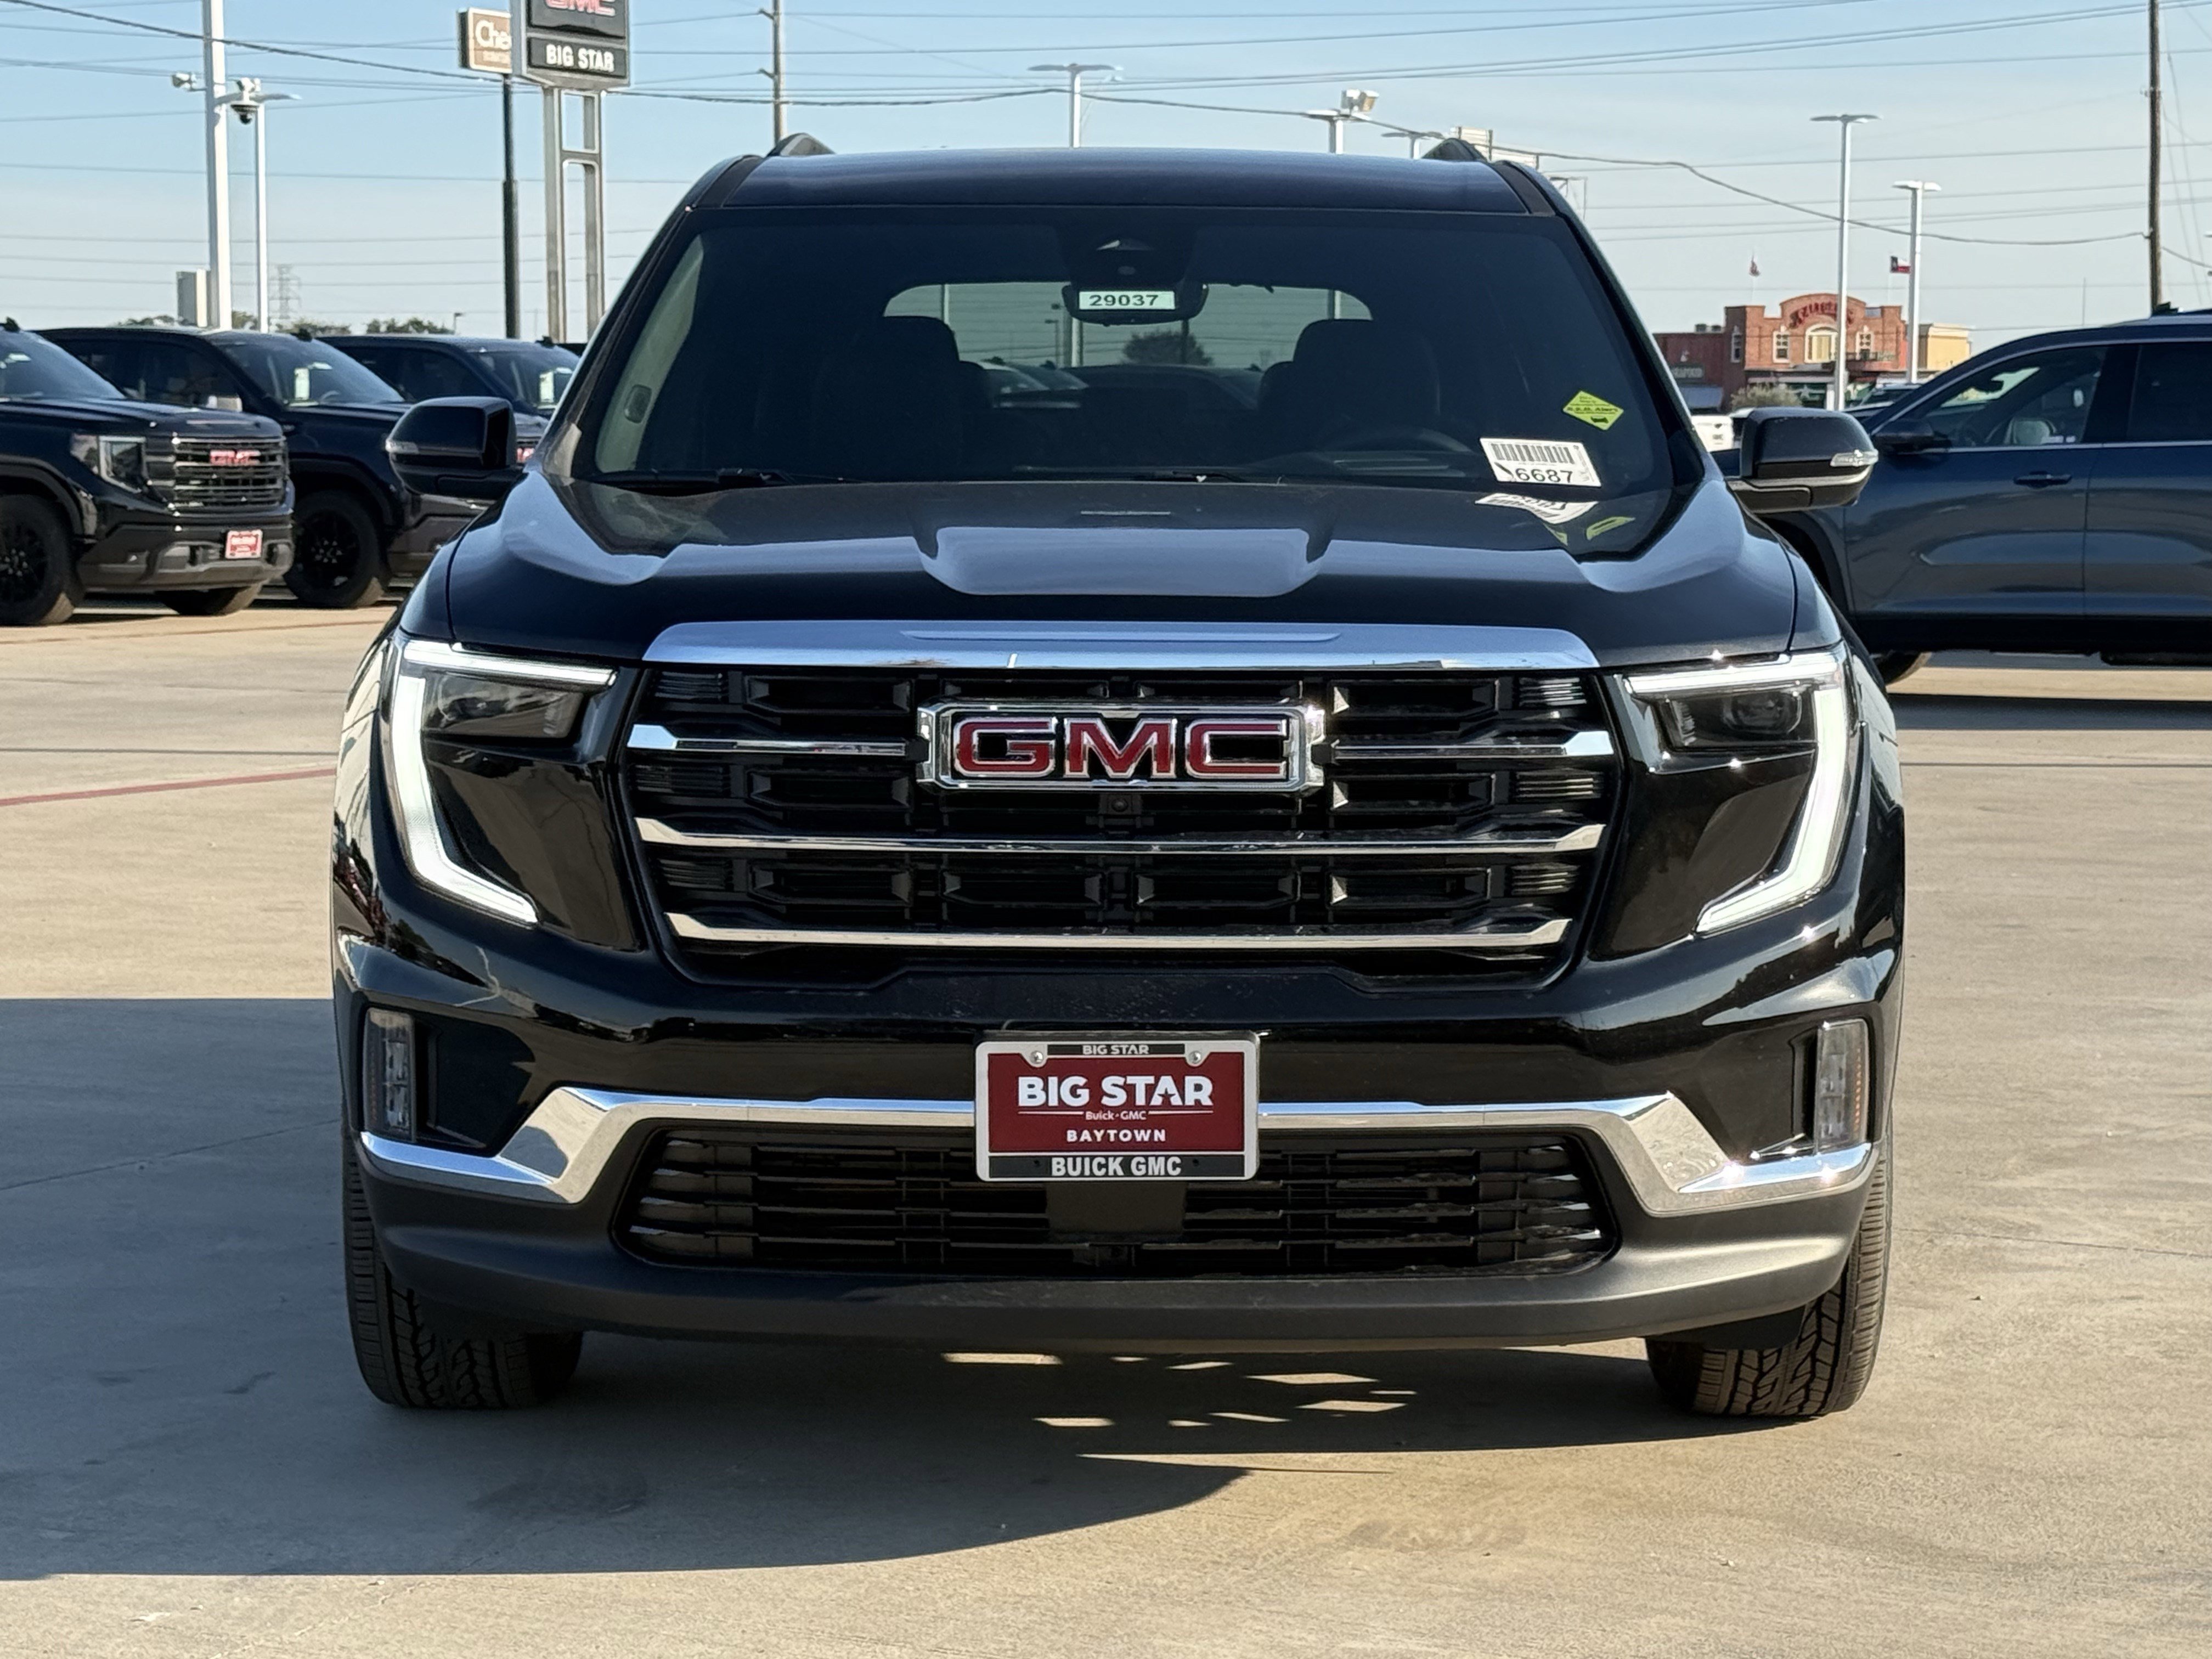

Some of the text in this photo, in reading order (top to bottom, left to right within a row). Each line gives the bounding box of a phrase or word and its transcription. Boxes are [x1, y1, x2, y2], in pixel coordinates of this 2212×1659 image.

[546, 44, 614, 72] BIG STAR
[1089, 294, 1159, 306] 29037
[954, 716, 1287, 780] GMC
[1082, 1045, 1149, 1054] BIG STAR
[1018, 1075, 1214, 1107] BIG STAR
[1066, 1129, 1166, 1142] BAYTOWN
[1051, 1156, 1182, 1176] BUICK GMC
